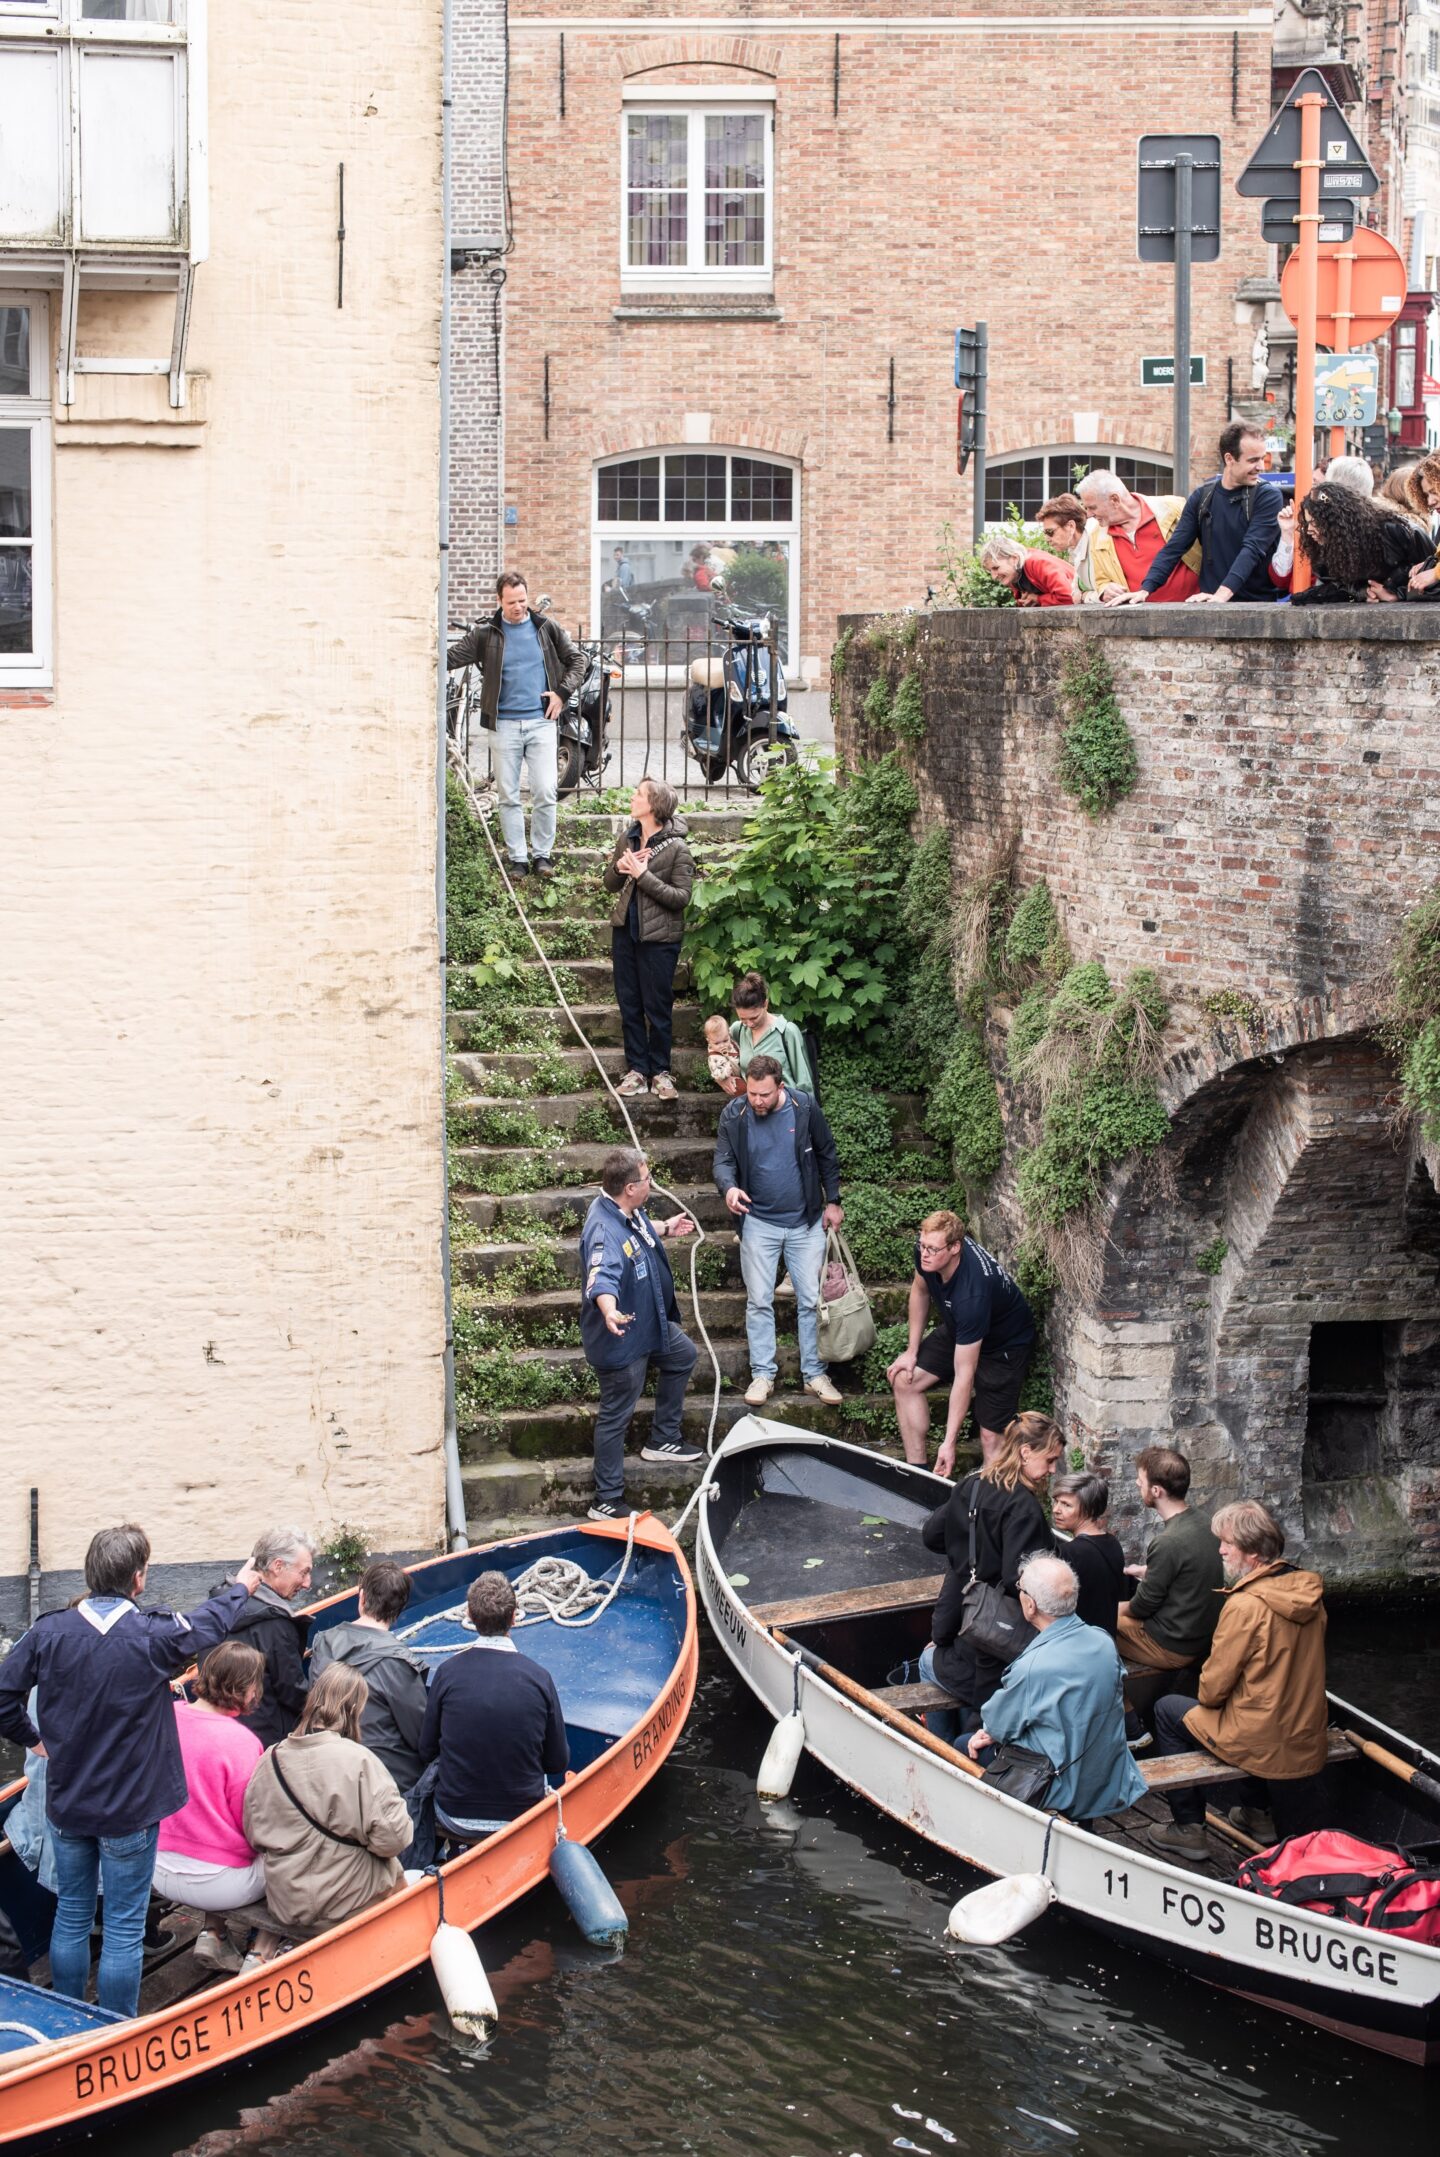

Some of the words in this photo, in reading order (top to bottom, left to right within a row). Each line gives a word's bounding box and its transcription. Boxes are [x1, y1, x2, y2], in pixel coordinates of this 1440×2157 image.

[632, 1673, 687, 1771] BRANDING
[1104, 1868, 1130, 1899] 11
[1162, 1886, 1226, 1935] FOS
[1255, 1916, 1399, 1986] BRUGGE
[75, 2015, 211, 2099] BRUGGE
[258, 1969, 314, 2023] FOS
